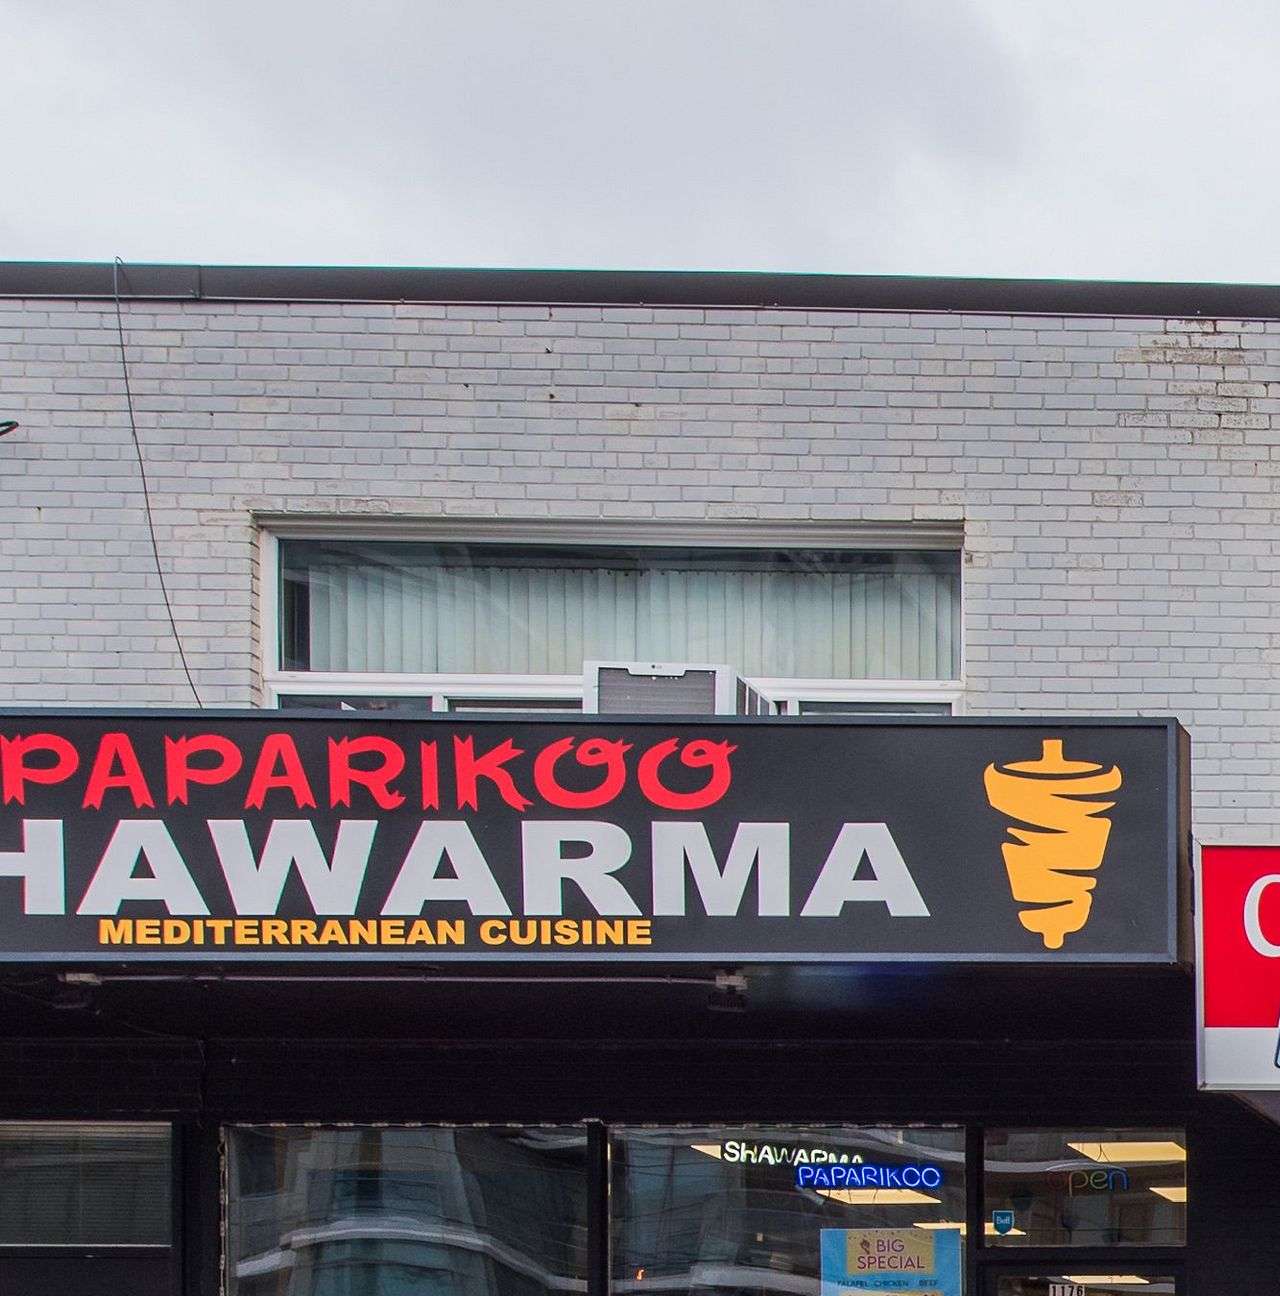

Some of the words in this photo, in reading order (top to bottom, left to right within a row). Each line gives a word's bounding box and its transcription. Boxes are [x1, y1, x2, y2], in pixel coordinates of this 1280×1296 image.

[0, 732, 738, 811] PAPARIKOO
[0, 818, 931, 917] HAWARMA
[99, 918, 465, 946] MEDITERRANEAN
[479, 918, 652, 946] CUISINE
[798, 1166, 941, 1188] PAPARIKOO
[876, 1239, 905, 1252] BIG
[857, 1256, 925, 1270] SPECIAL
